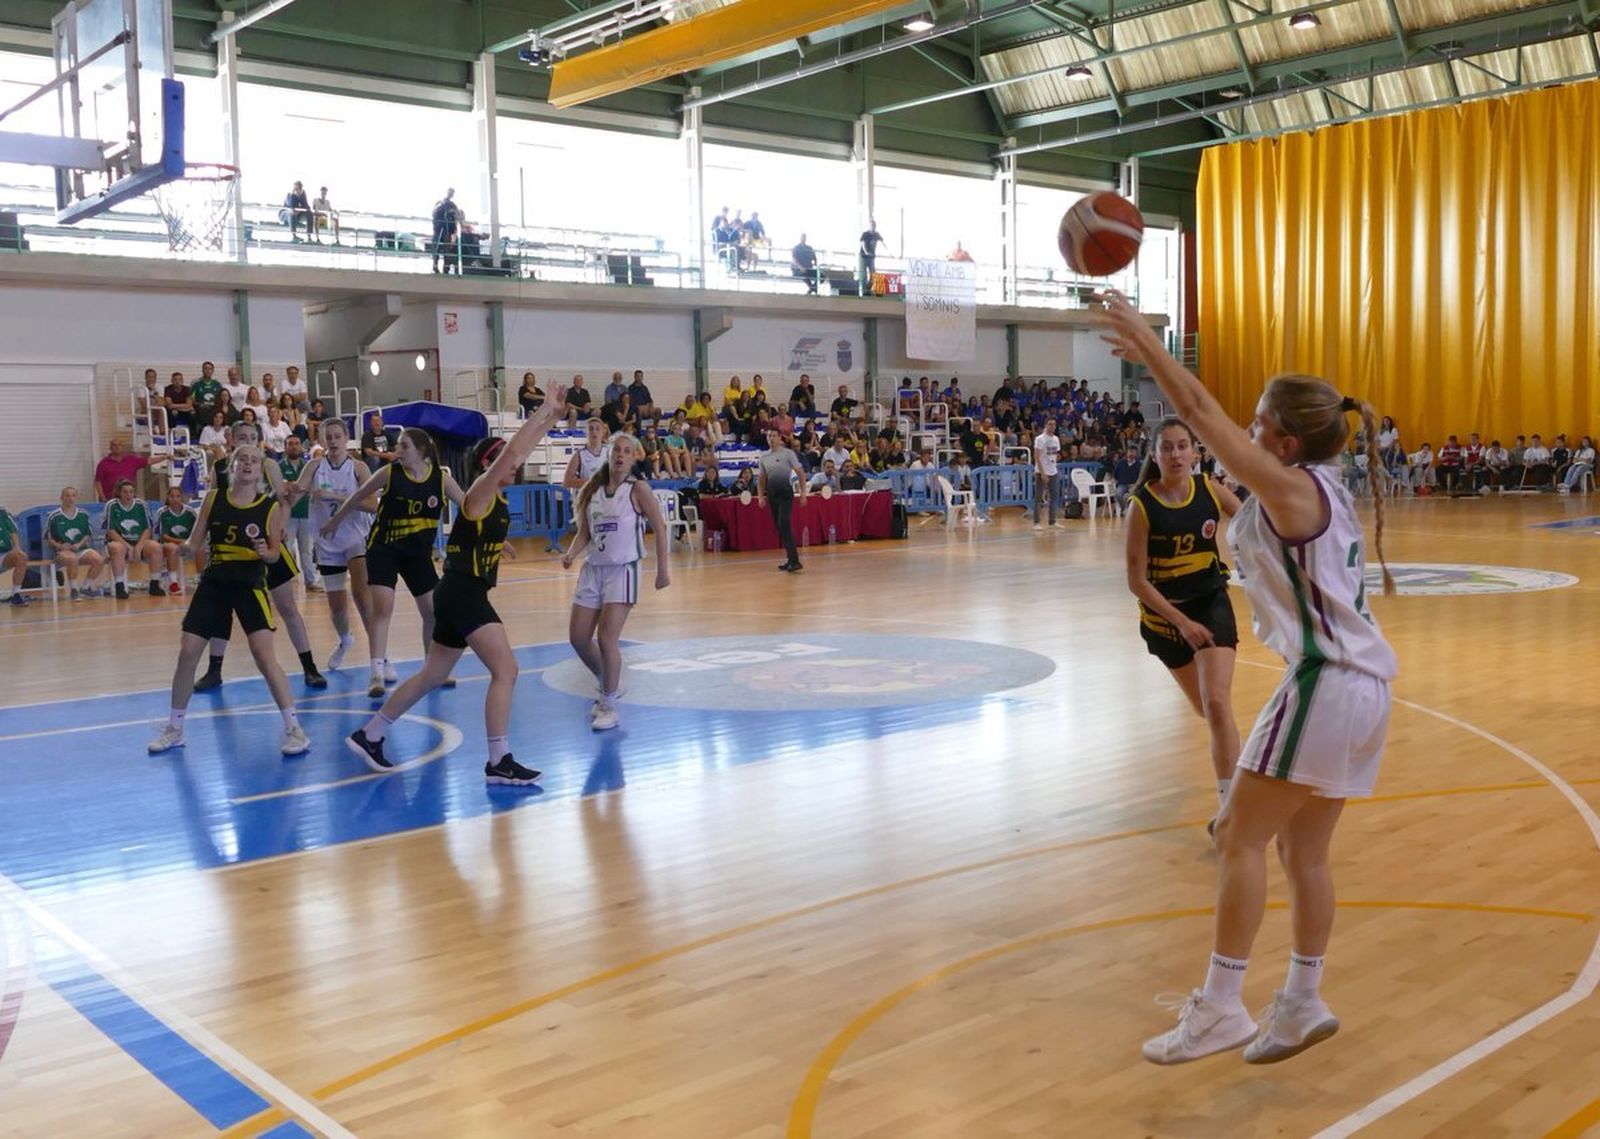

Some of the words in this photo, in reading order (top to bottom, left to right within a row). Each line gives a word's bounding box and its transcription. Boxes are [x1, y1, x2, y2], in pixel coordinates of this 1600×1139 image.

[922, 295, 960, 315] SOMNIS
[407, 499, 423, 515] 10
[224, 525, 238, 544] 5
[1172, 533, 1195, 556] 13
